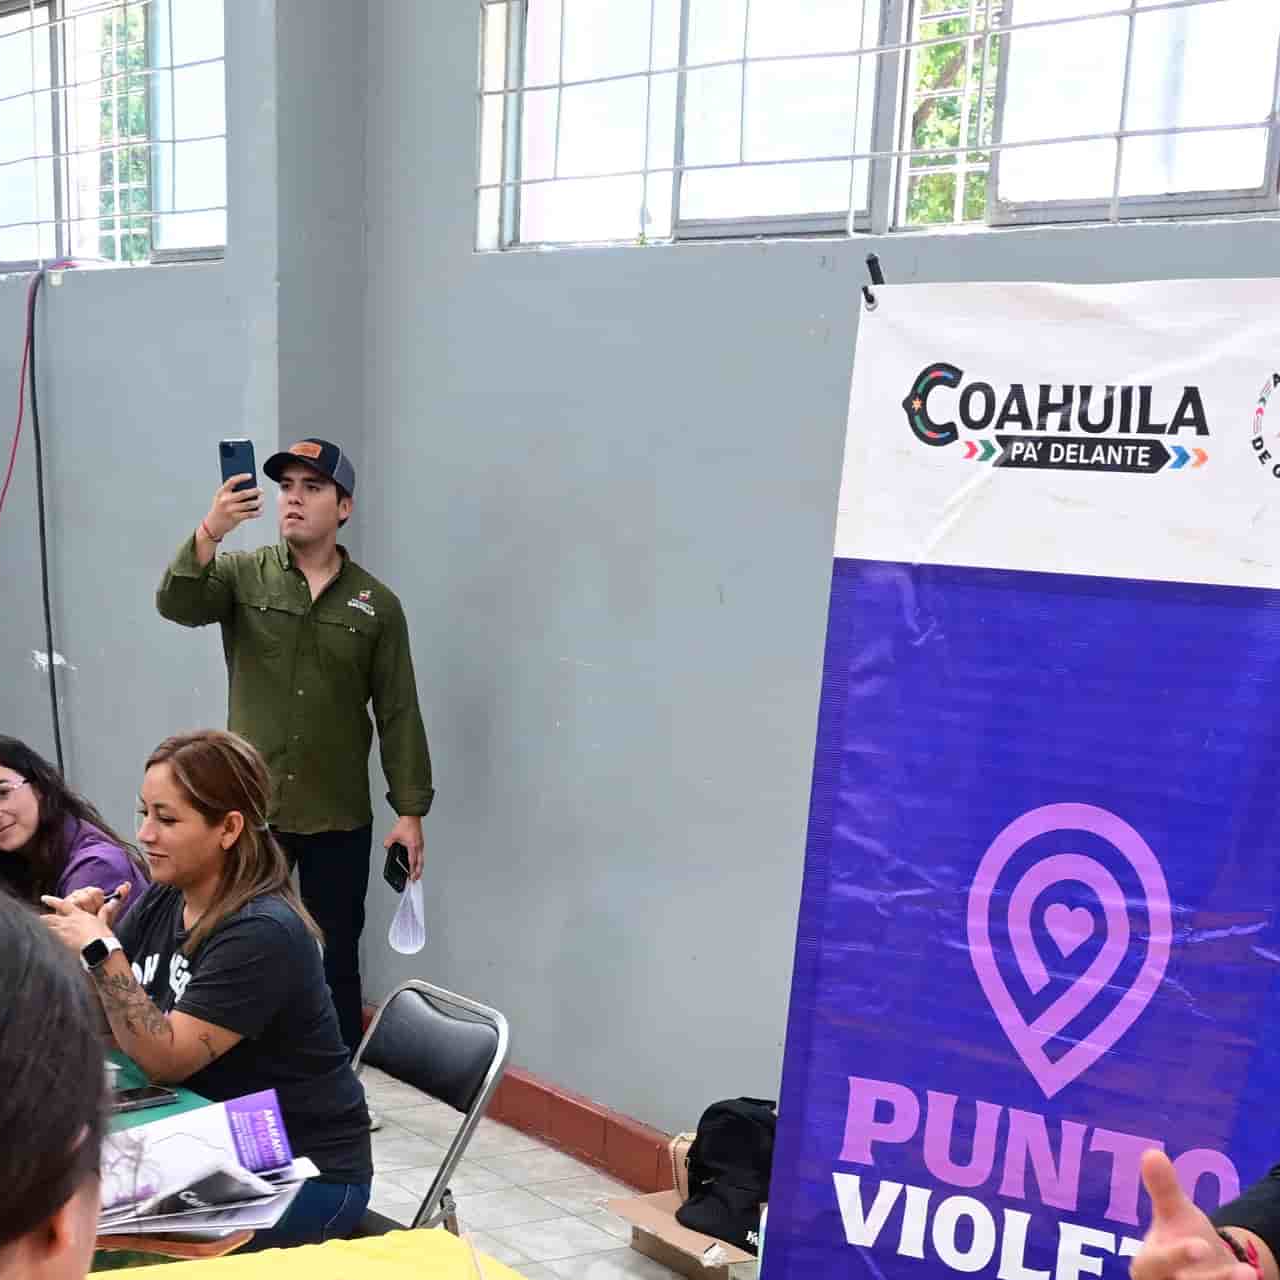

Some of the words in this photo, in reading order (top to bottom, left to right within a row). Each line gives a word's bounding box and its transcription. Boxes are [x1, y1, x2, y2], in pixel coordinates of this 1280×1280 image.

[902, 362, 1210, 447] COAHUILA
[1049, 443, 1150, 467] DELANTE
[1251, 436, 1272, 464] DE
[838, 1075, 1241, 1226] PUNTO
